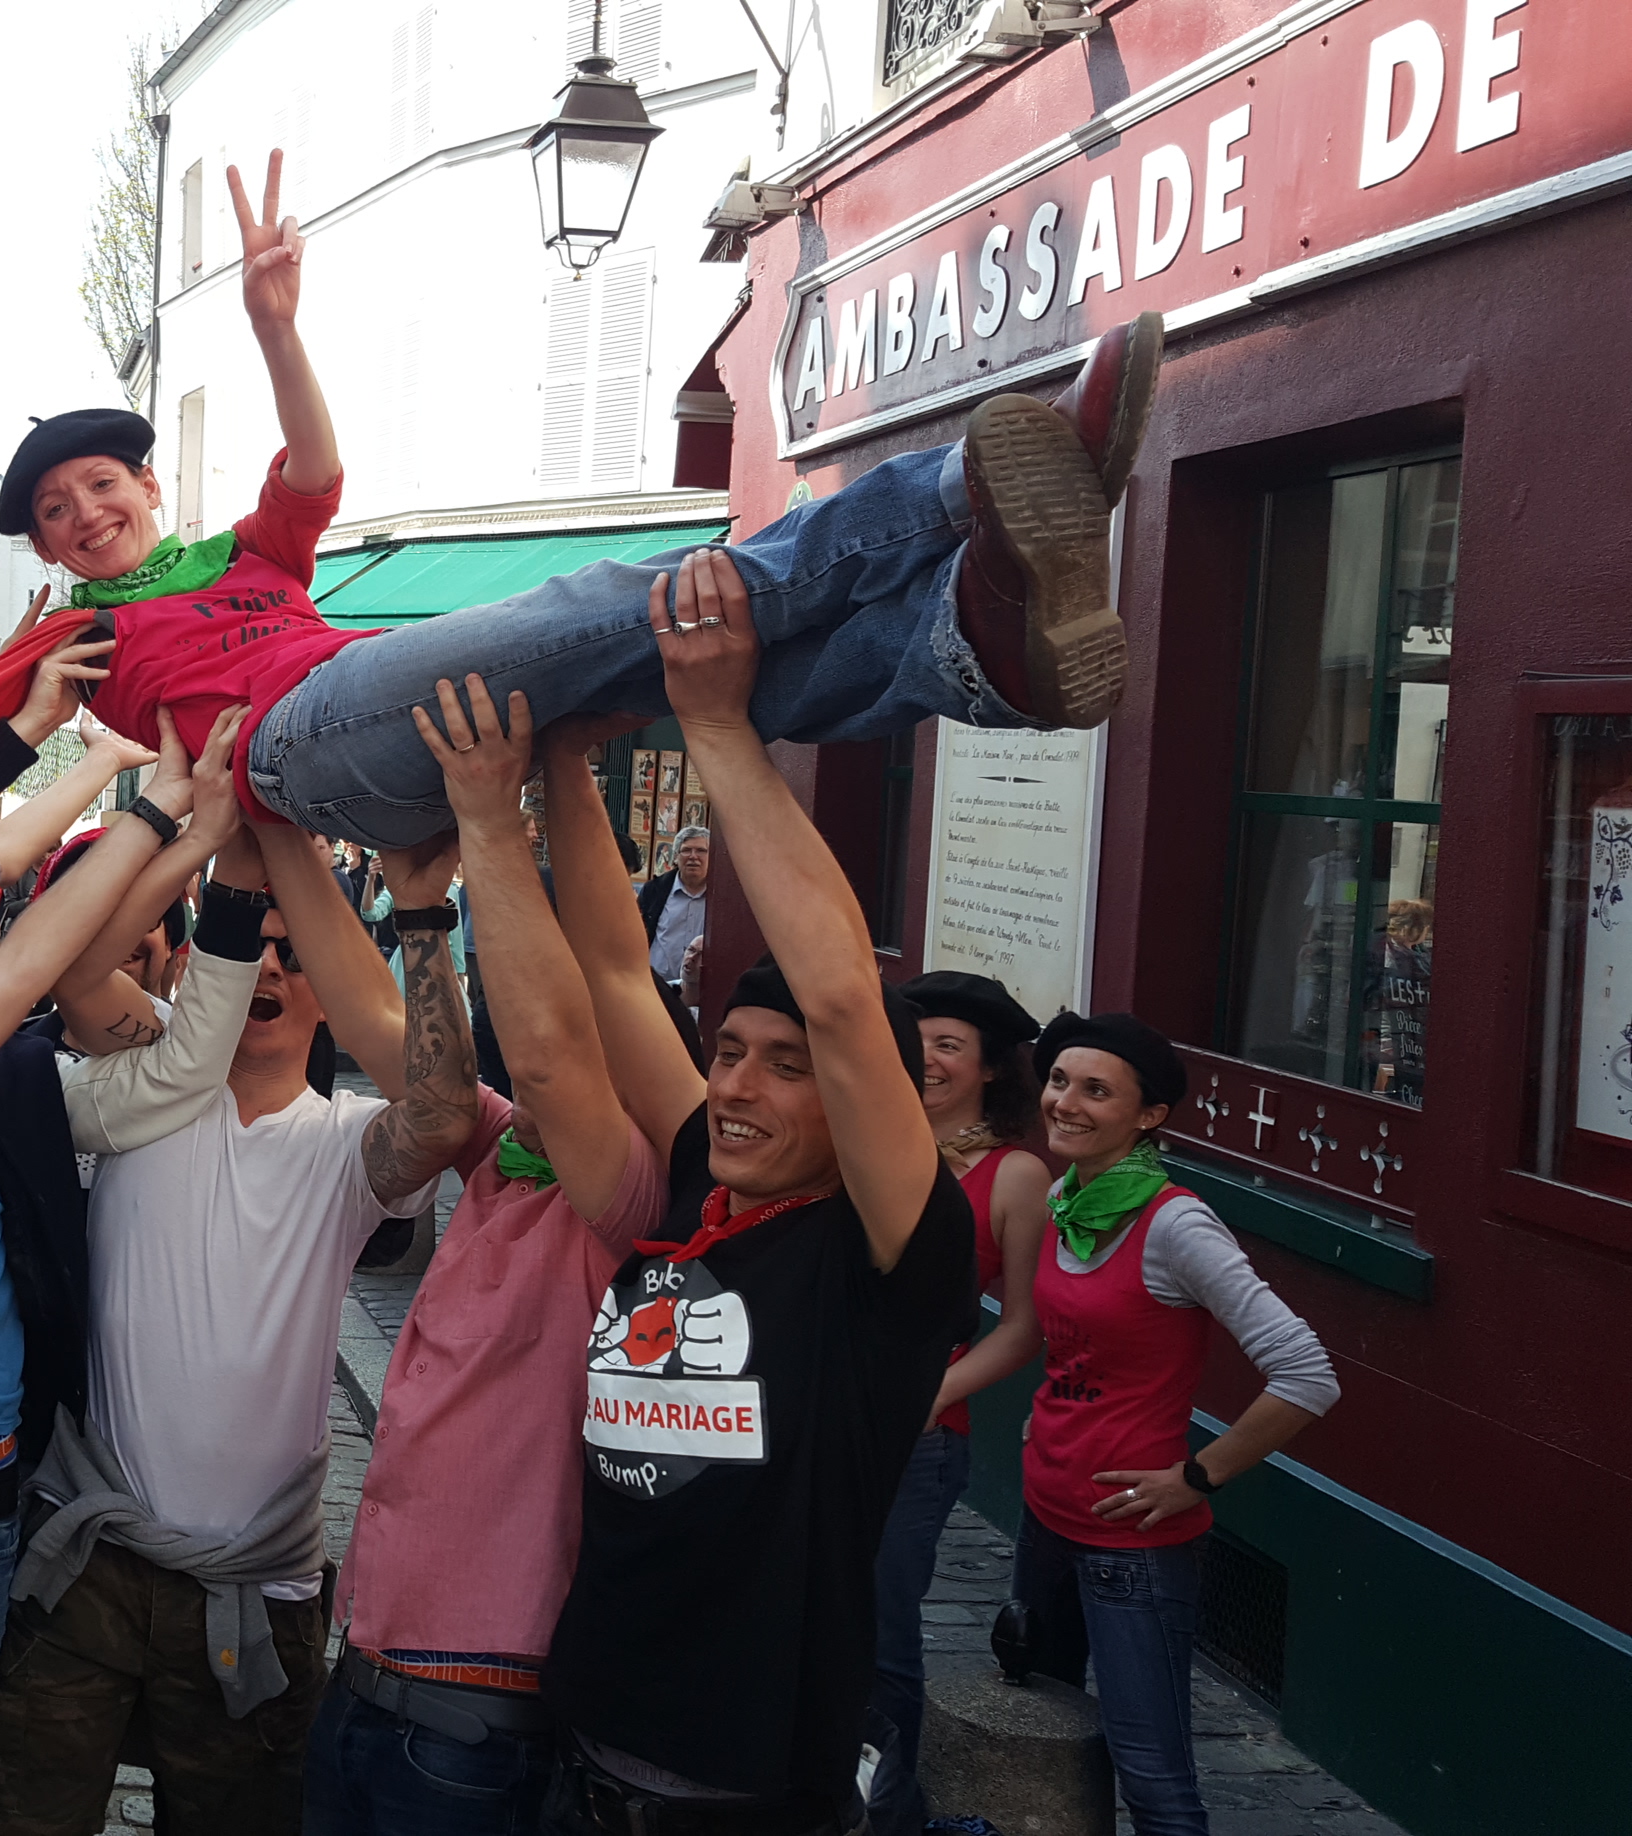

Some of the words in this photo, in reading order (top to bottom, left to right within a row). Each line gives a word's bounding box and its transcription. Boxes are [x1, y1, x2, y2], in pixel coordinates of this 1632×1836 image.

[793, 104, 1253, 411] AMBASSADE
[1361, 0, 1528, 190] DE
[999, 951, 1015, 965] 1997
[593, 1397, 619, 1425] AU
[625, 1400, 755, 1433] MARIAGE
